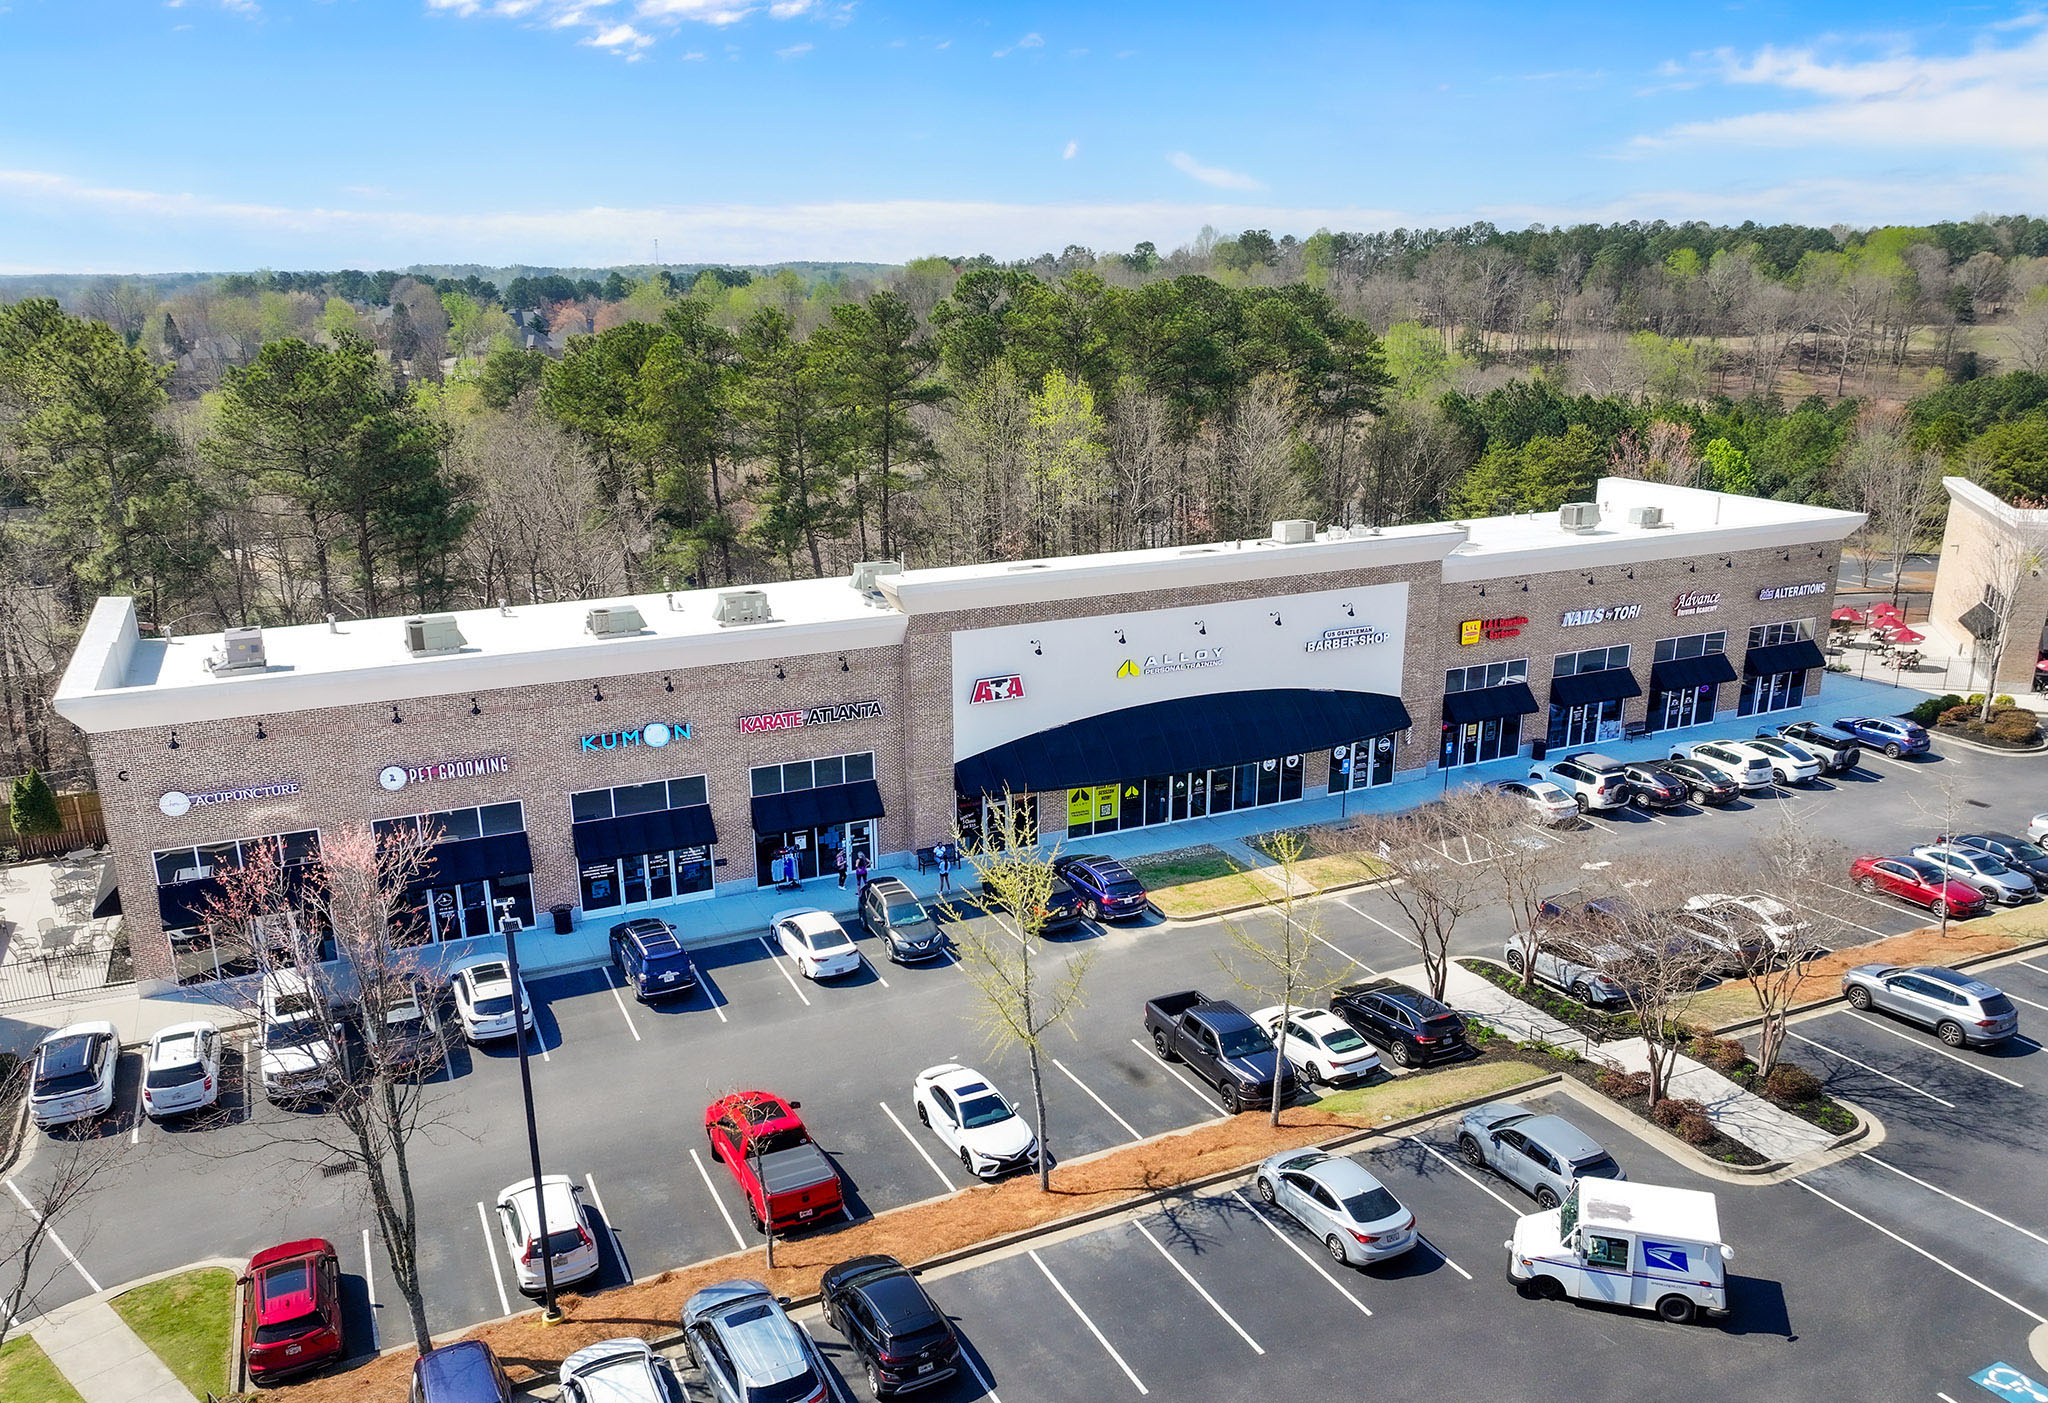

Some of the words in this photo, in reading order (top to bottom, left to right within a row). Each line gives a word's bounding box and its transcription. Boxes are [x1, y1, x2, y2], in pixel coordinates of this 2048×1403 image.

[1674, 591, 1720, 610] Advance
[1774, 582, 1826, 599] ALTERATIONS
[1561, 607, 1605, 627] NAILS
[1613, 604, 1642, 620] TORI
[1306, 637, 1356, 652] BARBER
[1358, 632, 1390, 646] SHOP
[1336, 627, 1373, 637] GENTLEMAN
[1144, 647, 1224, 667] ALLOY
[1144, 664, 1184, 675] PERSONAL
[1183, 659, 1223, 670] TRAINING
[741, 710, 803, 733] KARATE
[807, 701, 884, 725] ATLANTA
[581, 723, 691, 752] KUMON
[409, 766, 434, 784] PET
[438, 757, 508, 780] GROOMING
[195, 783, 300, 806] ACUPUNCTURE
